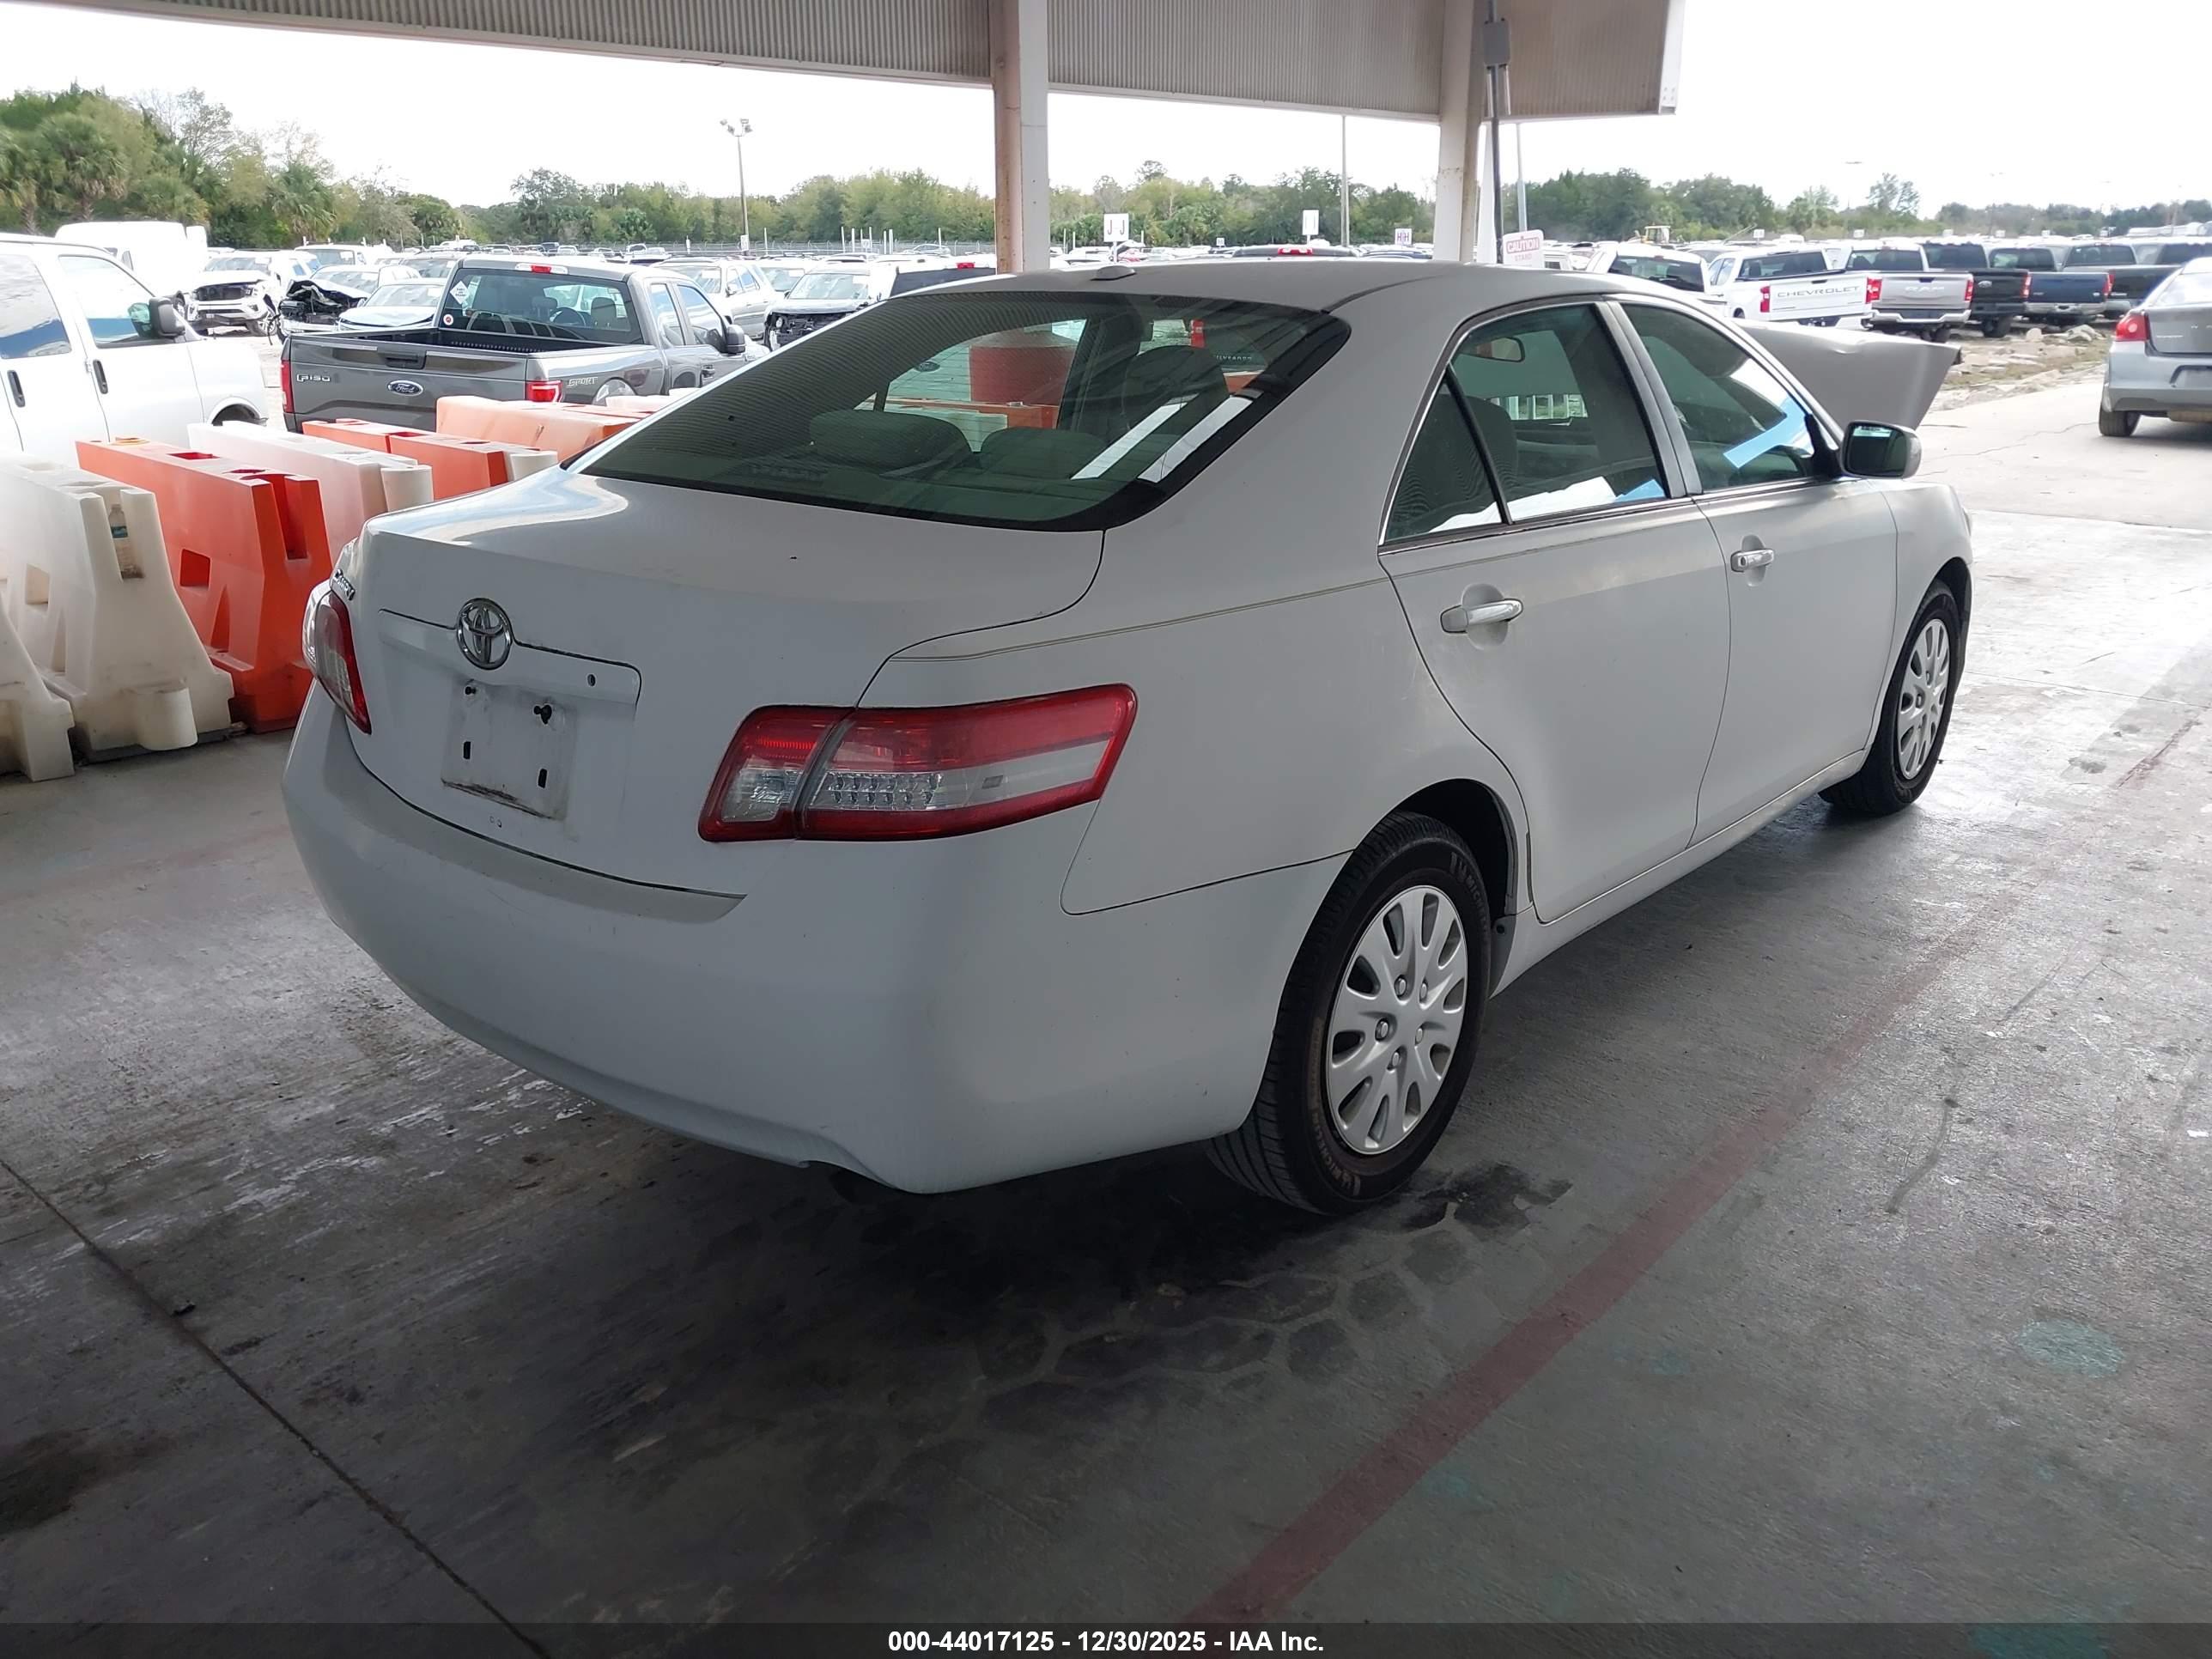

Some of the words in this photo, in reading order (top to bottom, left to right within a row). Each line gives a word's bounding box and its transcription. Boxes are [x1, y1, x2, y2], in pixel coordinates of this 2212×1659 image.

[1507, 238, 1539, 252] CAUTION
[1777, 286, 1860, 298] CHEVROLET
[567, 376, 599, 388] SPORT
